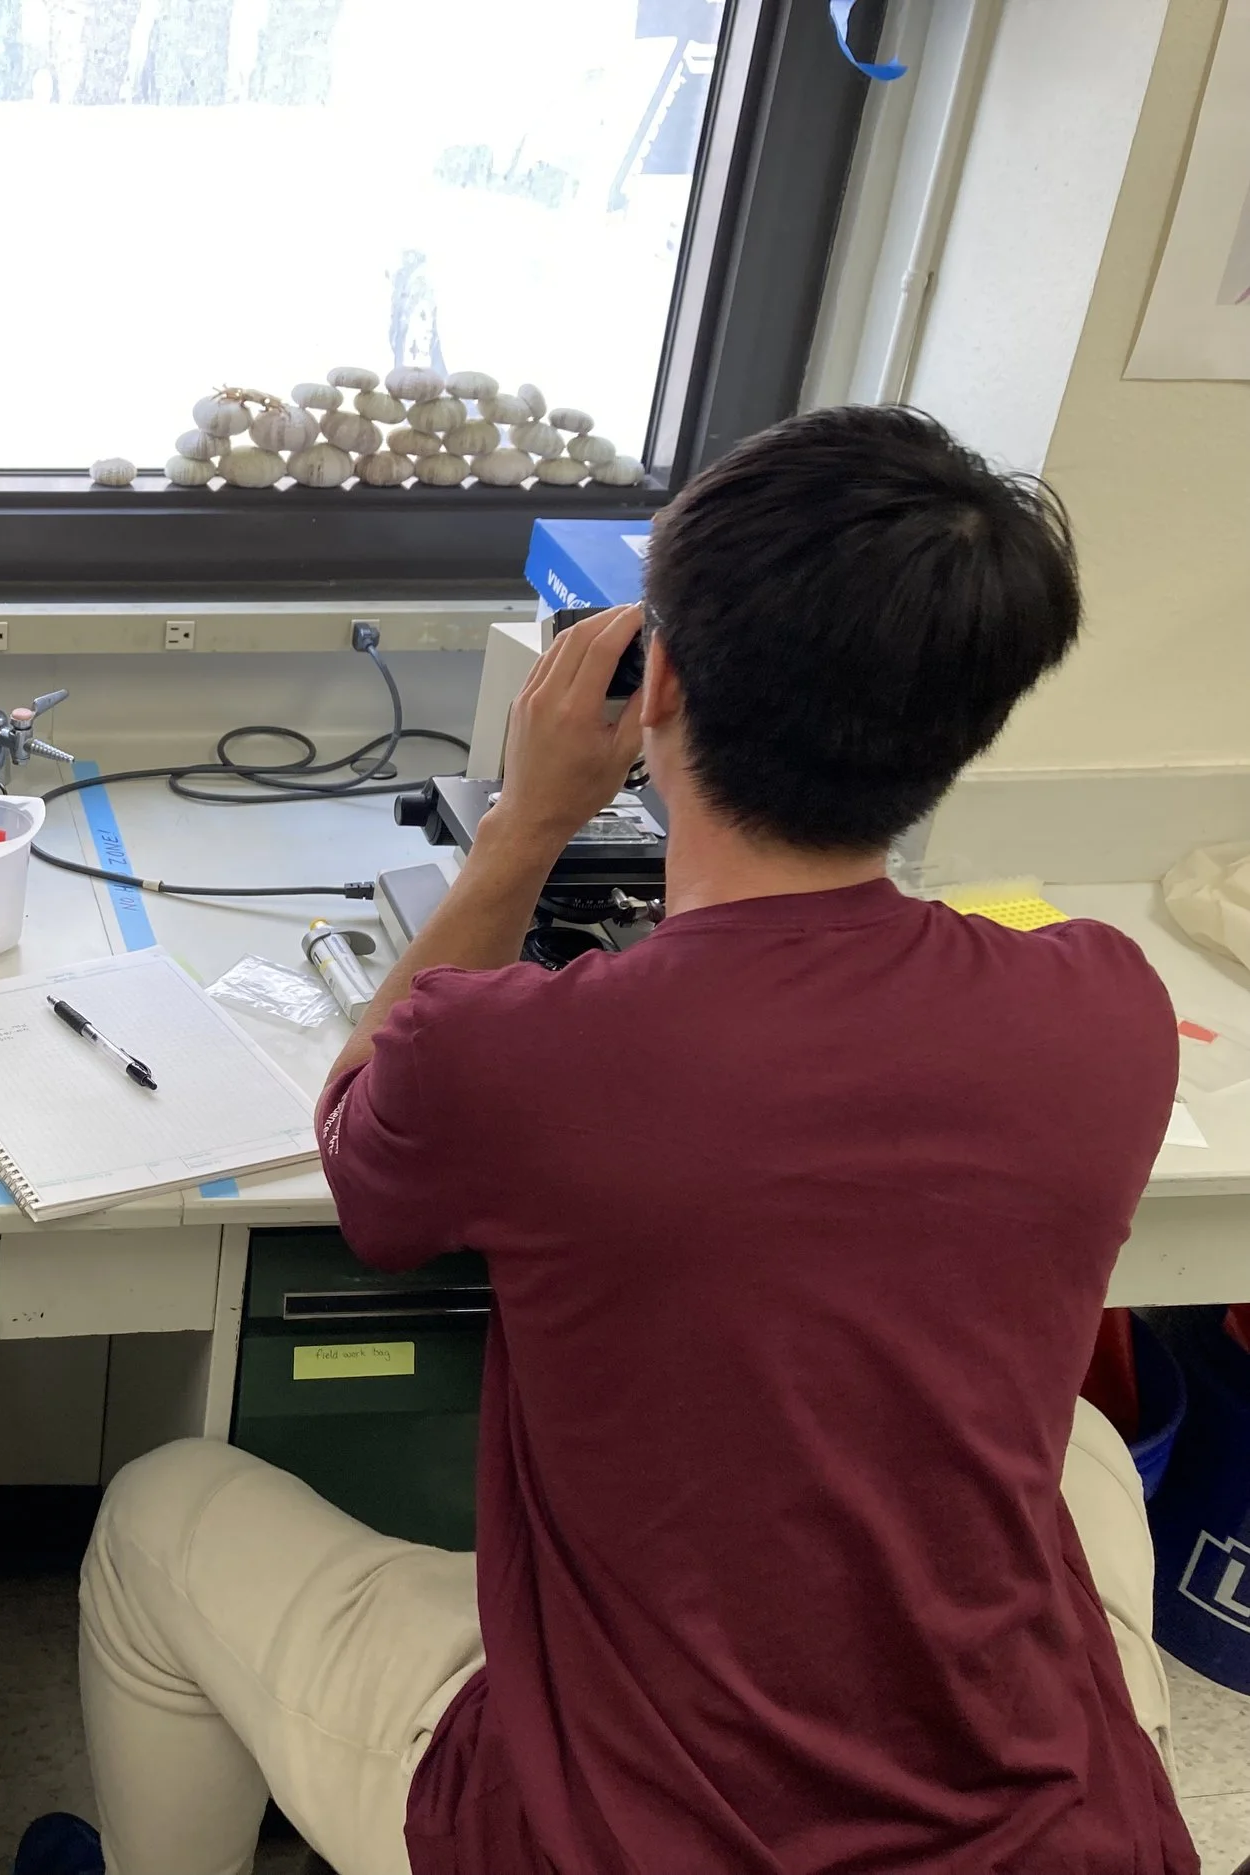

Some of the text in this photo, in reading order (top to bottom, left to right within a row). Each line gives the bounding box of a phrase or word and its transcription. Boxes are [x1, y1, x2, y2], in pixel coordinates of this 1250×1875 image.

[547, 568, 569, 604] VWR
[343, 1348, 366, 1359] work
[373, 1346, 391, 1361] bag
